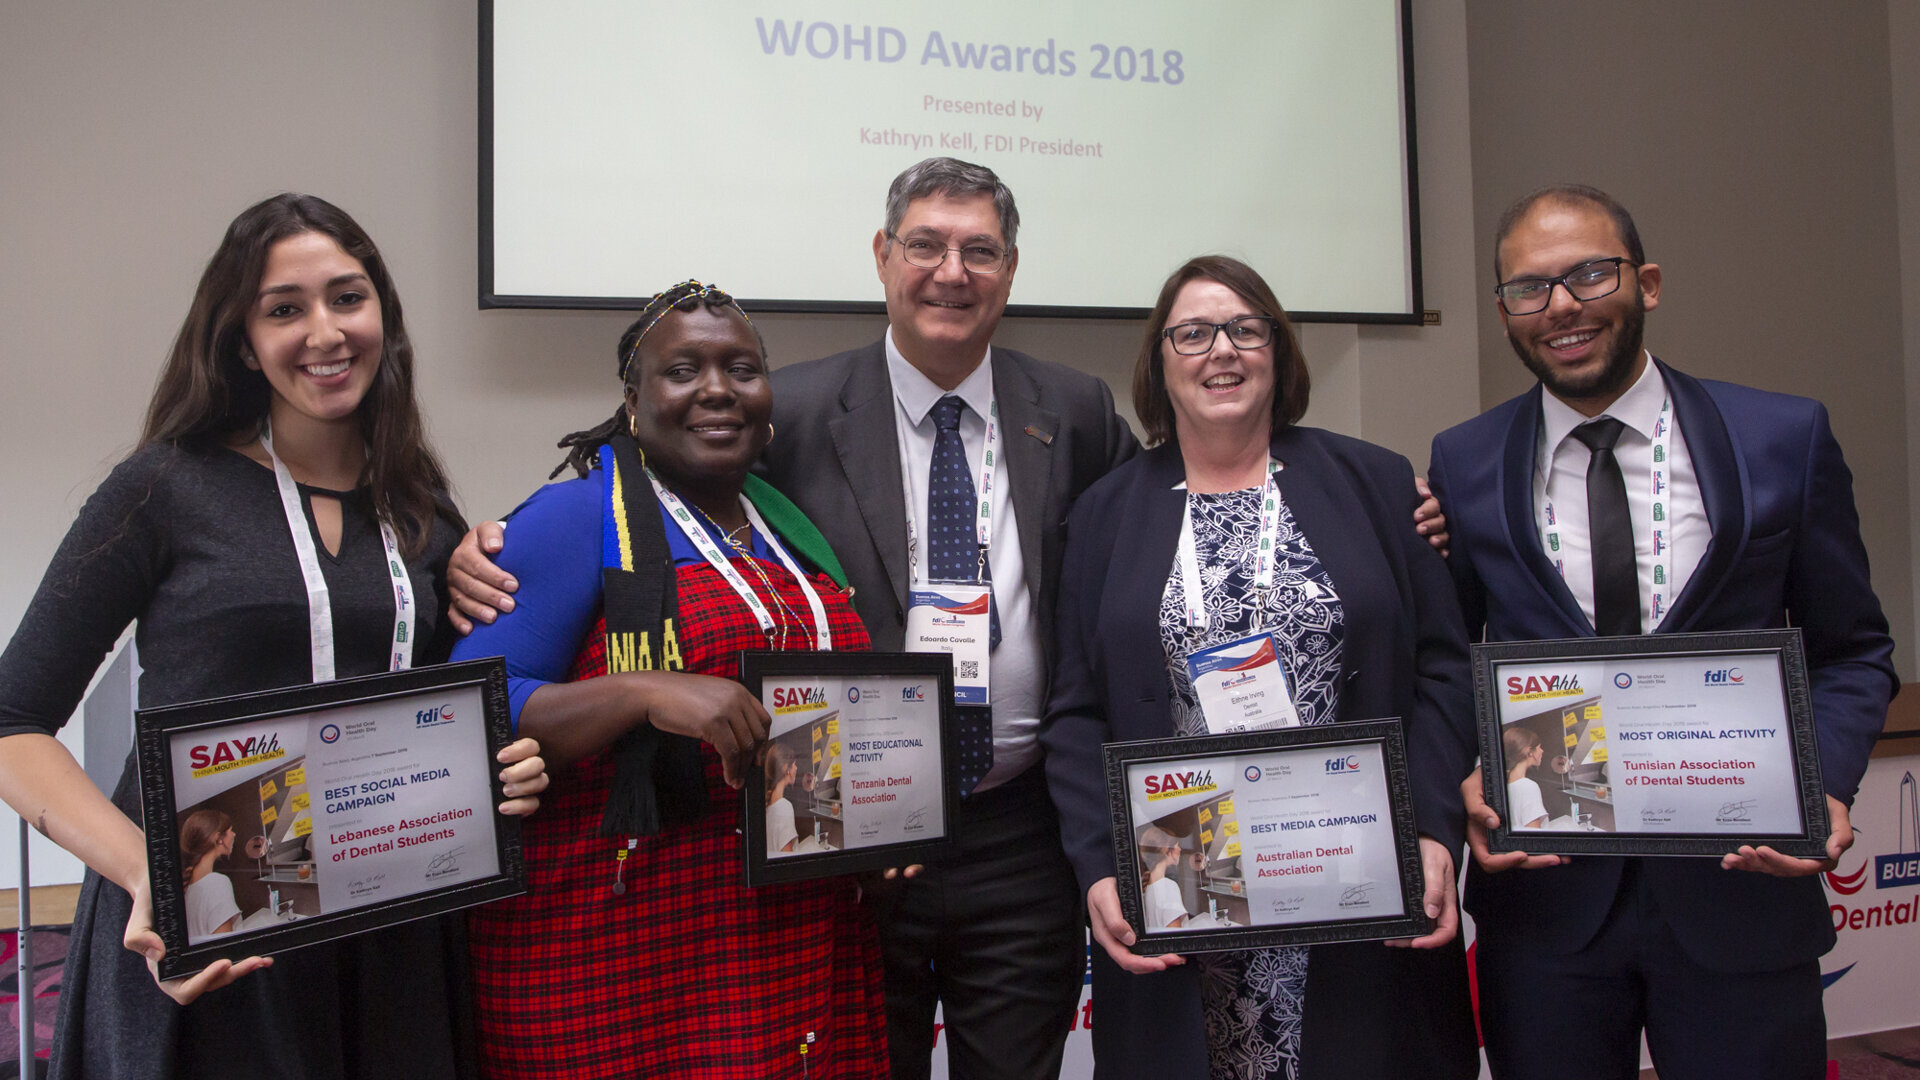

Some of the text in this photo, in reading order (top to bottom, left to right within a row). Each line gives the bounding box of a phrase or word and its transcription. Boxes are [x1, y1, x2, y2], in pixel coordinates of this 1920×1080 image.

[755, 16, 1186, 86] WOHD Awards 2018
[923, 94, 1044, 123] Presented by
[860, 127, 1103, 159] Kathryn Kell, FDI President
[606, 631, 652, 674] NIA
[1507, 674, 1580, 695] SAY Ahh
[1704, 670, 1727, 682] fdi
[773, 686, 826, 708] SAY Ahh
[902, 687, 916, 699] fdi
[416, 708, 439, 725] fdi
[346, 722, 363, 730] World
[346, 728, 364, 736] Health
[1620, 728, 1776, 740] MOST ORIGINAL ACTIVITY
[189, 732, 280, 770] SAY Ahh
[849, 738, 924, 751] MOST EDUCATIONAL
[850, 752, 883, 763] ACTIVITY
[1324, 758, 1345, 772] fdi
[1623, 760, 1755, 770] Tunisian Association
[214, 761, 240, 772] MOUTH
[325, 768, 450, 800] BEST SOCIAL MEDIA
[851, 776, 912, 790] Tanzania Dental
[1144, 769, 1214, 794] SAY Ahh
[1625, 775, 1745, 786] of Dental Students
[326, 792, 396, 814] CAMPAIGN
[851, 792, 896, 805] Association
[330, 824, 395, 845] Lebanese
[398, 807, 473, 831] Association
[1251, 814, 1376, 834] BEST MEDIA CAMPAIGN
[332, 828, 455, 863] of Dental Students
[1256, 845, 1354, 862] Australian Dental
[1258, 864, 1323, 878] Association
[1882, 862, 1920, 880] BUE
[1830, 894, 1919, 932] Dental
